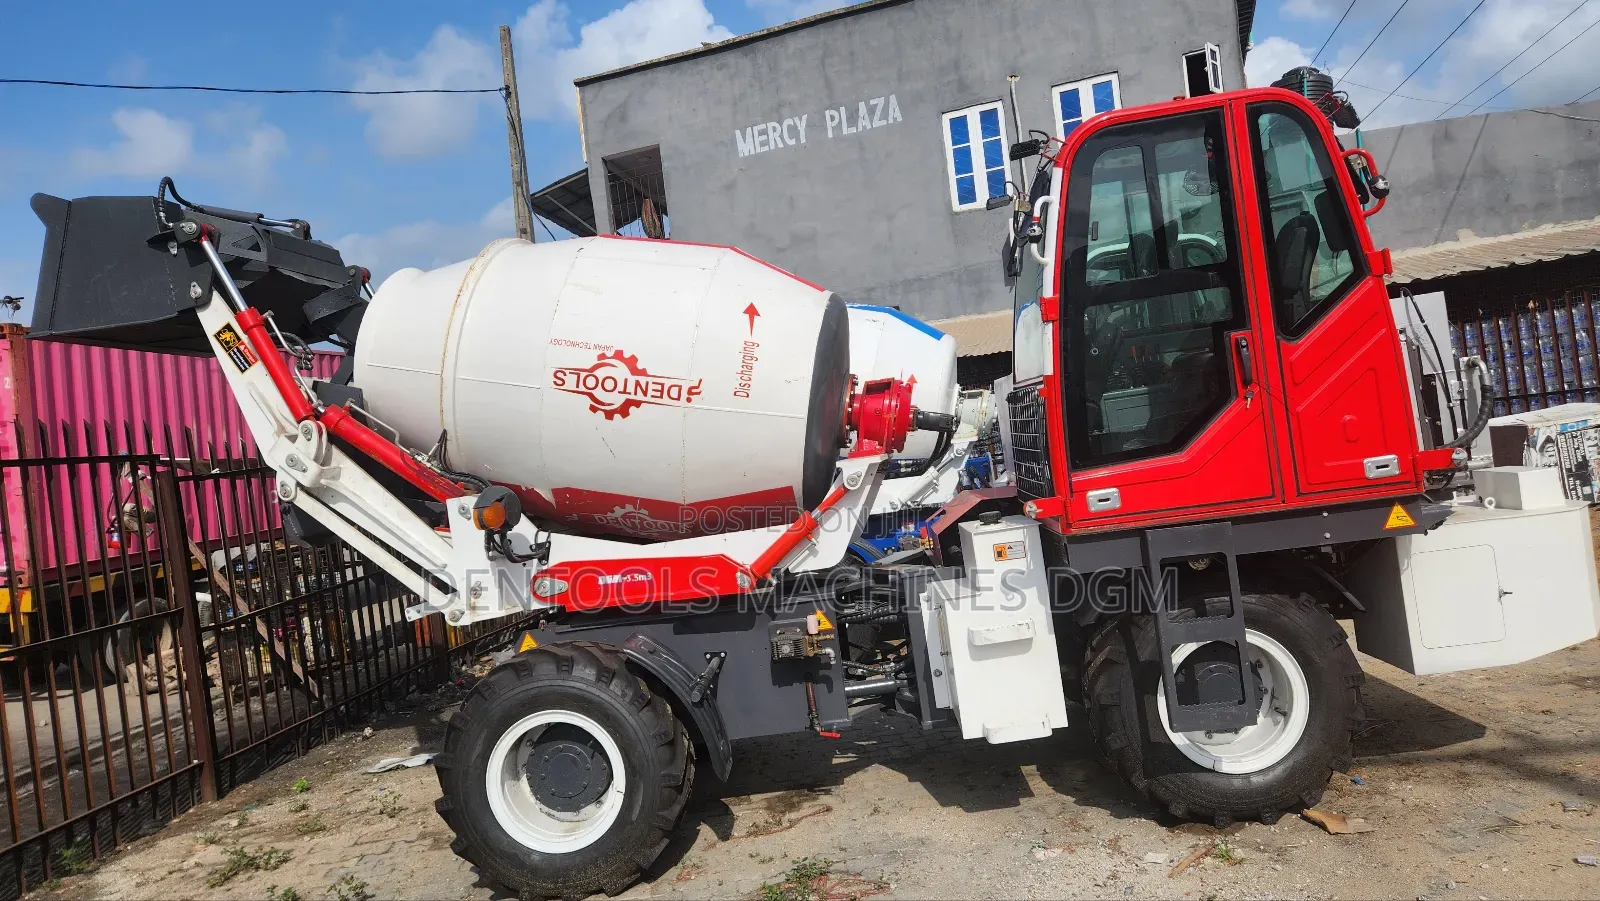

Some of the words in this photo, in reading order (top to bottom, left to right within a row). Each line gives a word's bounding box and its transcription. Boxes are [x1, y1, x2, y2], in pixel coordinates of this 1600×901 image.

[735, 114, 808, 158] MERCY
[825, 93, 903, 138] PLAZA
[549, 338, 592, 350] TECHNOLOGY
[593, 343, 614, 352] JAPAN
[552, 369, 683, 401] DENTOOLS
[733, 340, 760, 398] Discharging
